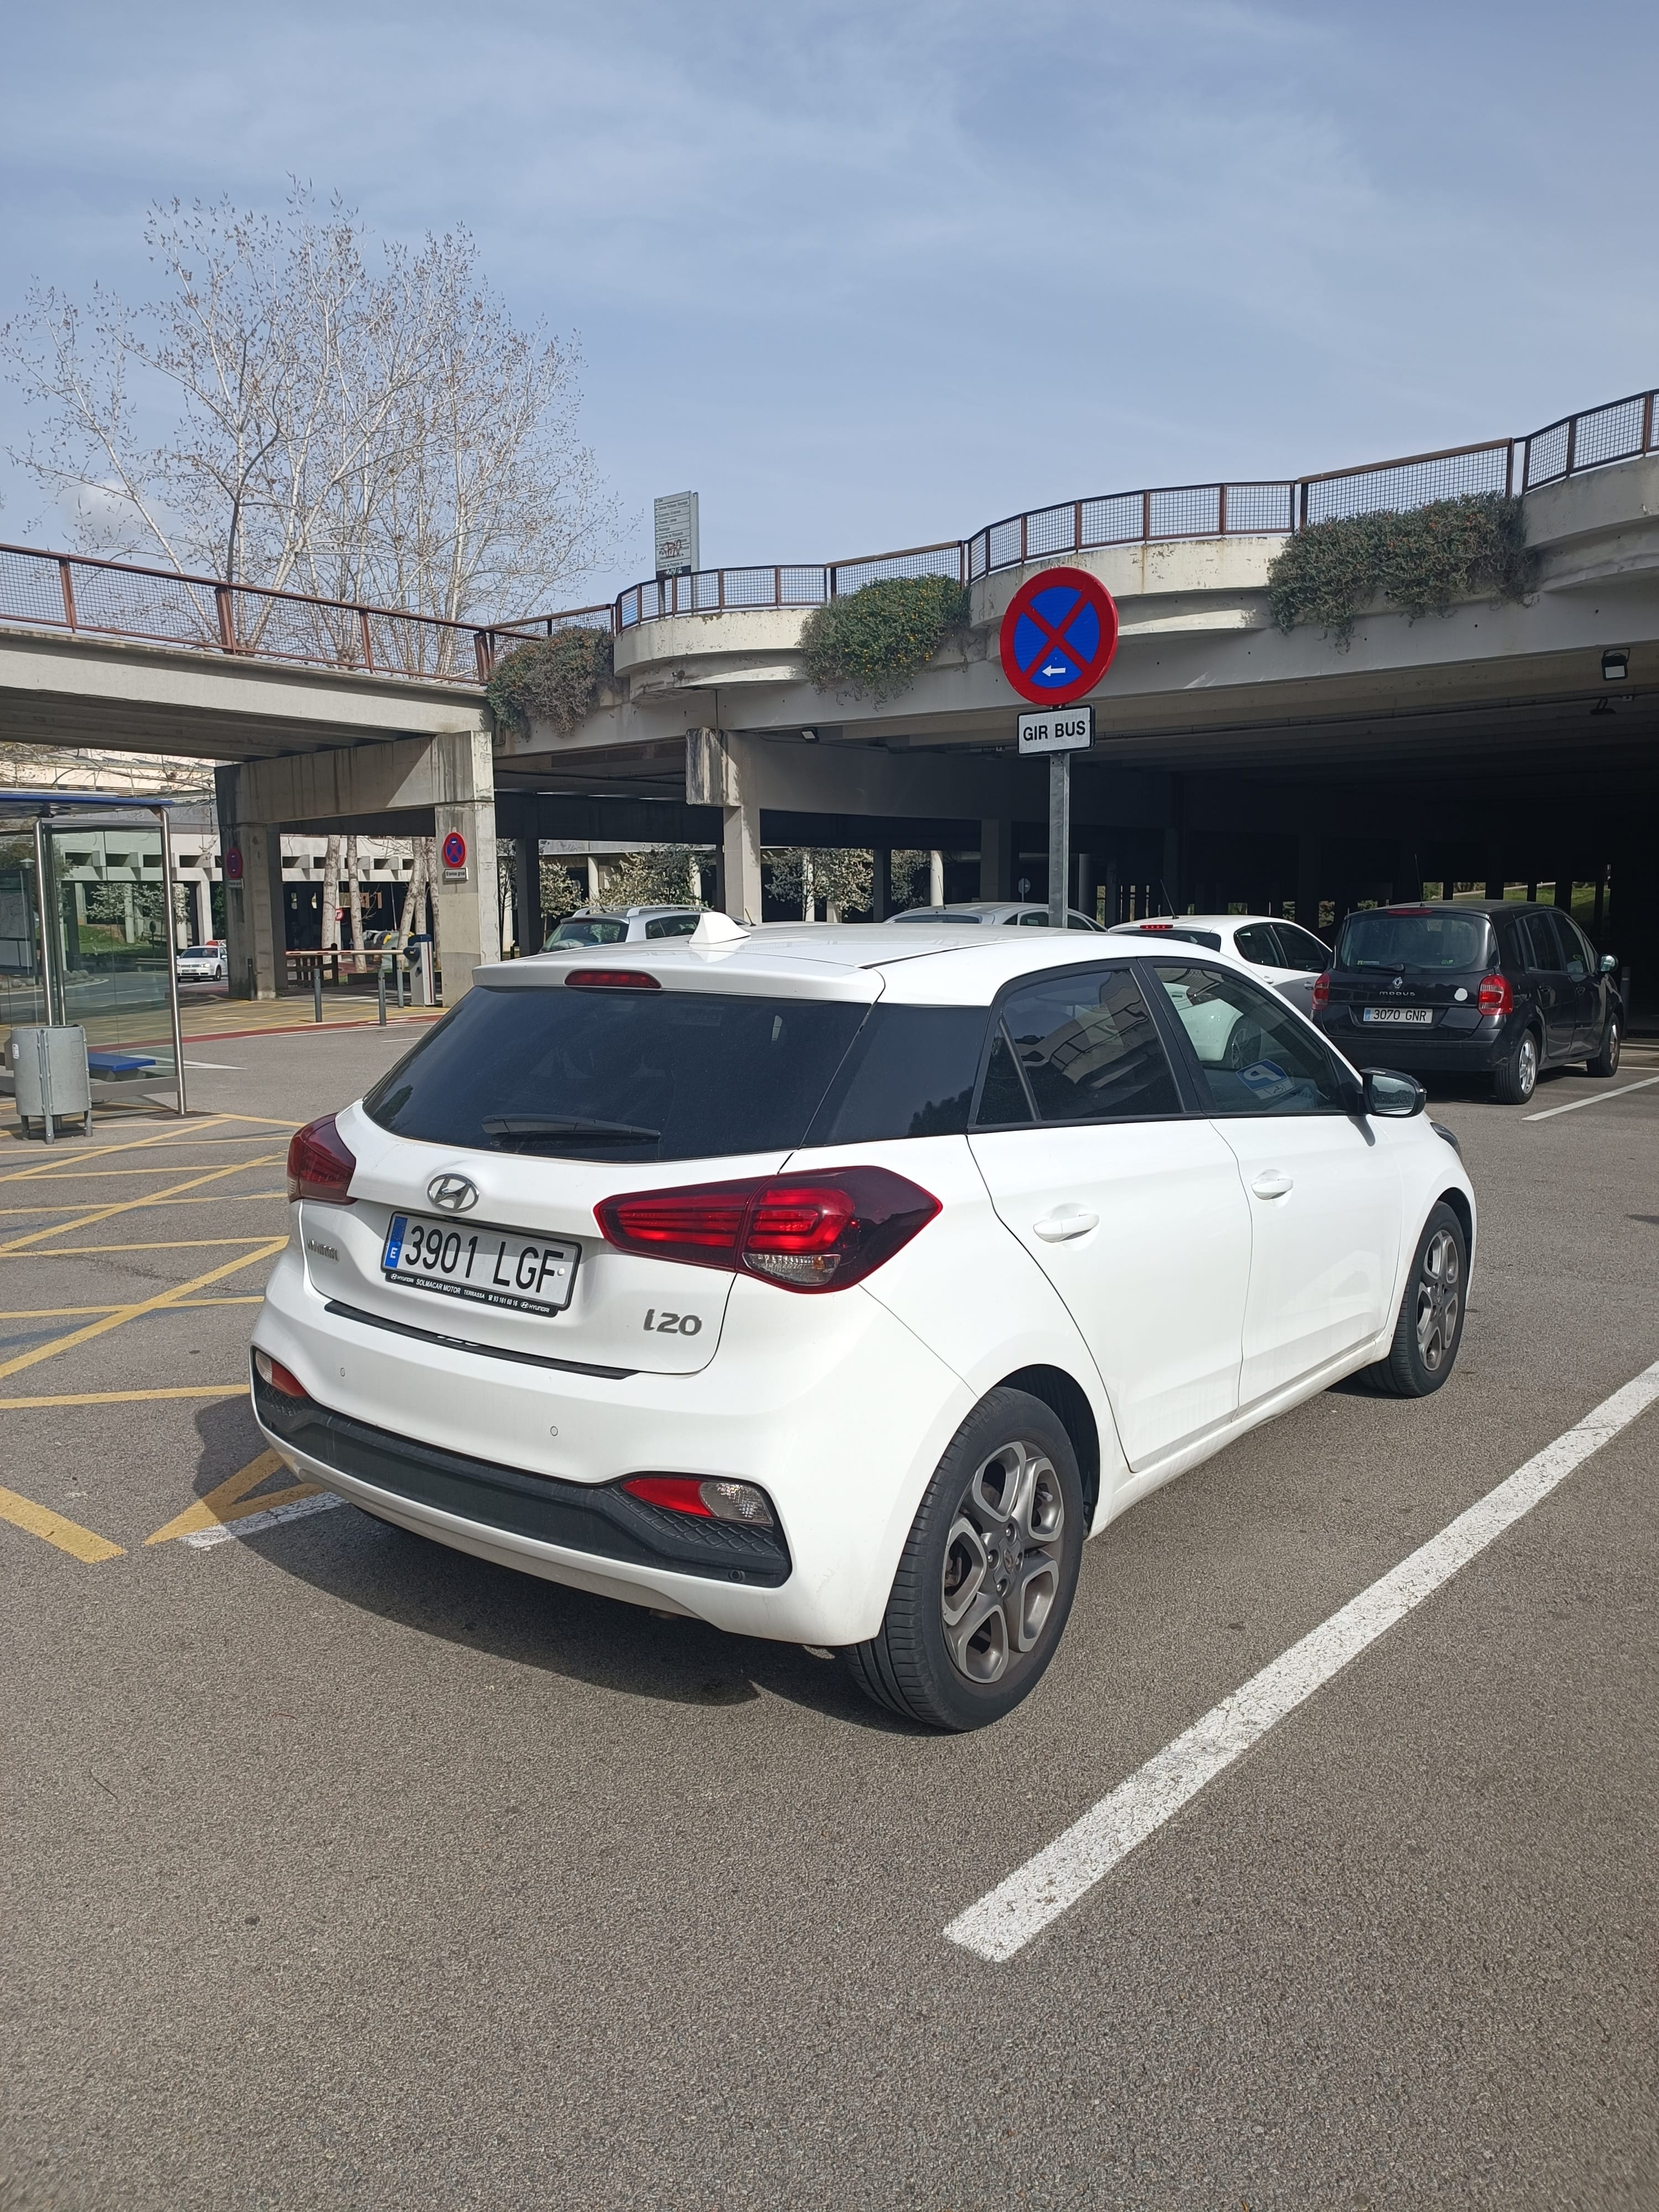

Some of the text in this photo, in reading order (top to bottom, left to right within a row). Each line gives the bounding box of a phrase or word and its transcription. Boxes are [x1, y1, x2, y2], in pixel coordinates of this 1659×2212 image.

[1023, 720, 1086, 741] GIR BUS
[1373, 1009, 1427, 1021] 3070 GNR
[389, 1247, 398, 1259] E
[405, 1225, 564, 1293] 3901 LGF
[415, 1279, 443, 1290] SOLMACAR
[443, 1284, 461, 1295] MOTOR
[463, 1290, 485, 1299] TERRASSA
[529, 1304, 550, 1313] HYUNDAI
